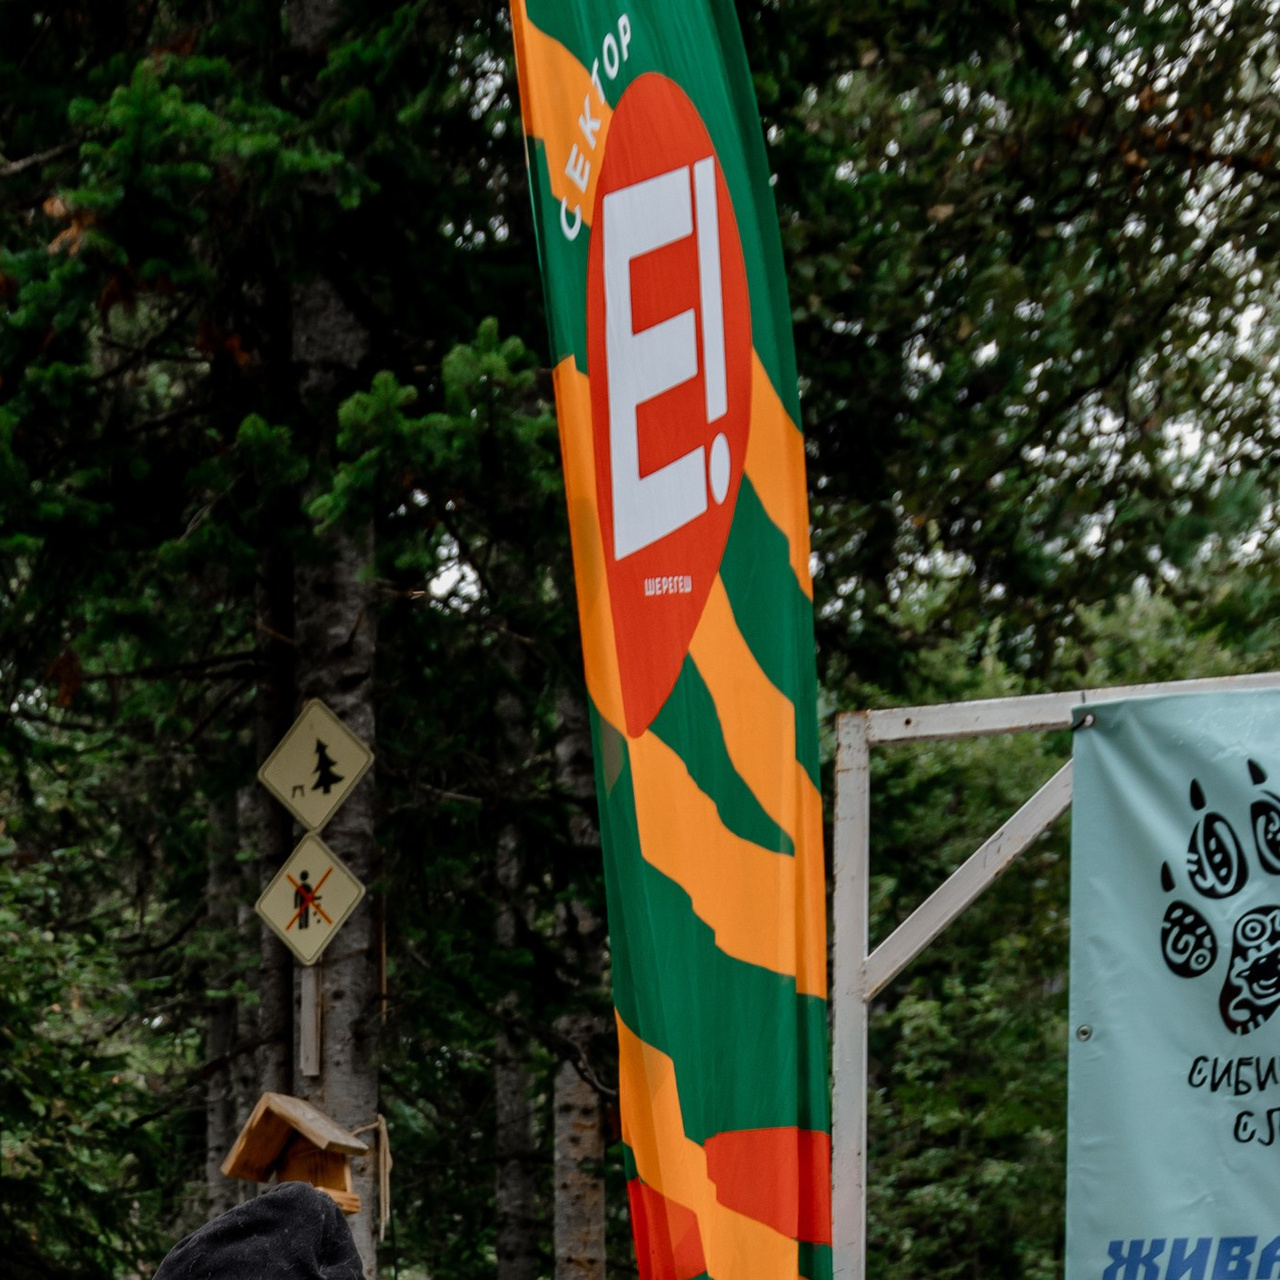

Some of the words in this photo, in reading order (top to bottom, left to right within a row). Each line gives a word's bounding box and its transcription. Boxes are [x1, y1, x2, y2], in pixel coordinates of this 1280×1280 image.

[559, 12, 632, 242] СЕКТОР
[602, 155, 732, 561] Е!
[644, 576, 693, 597] ШЕРЕГЕШ
